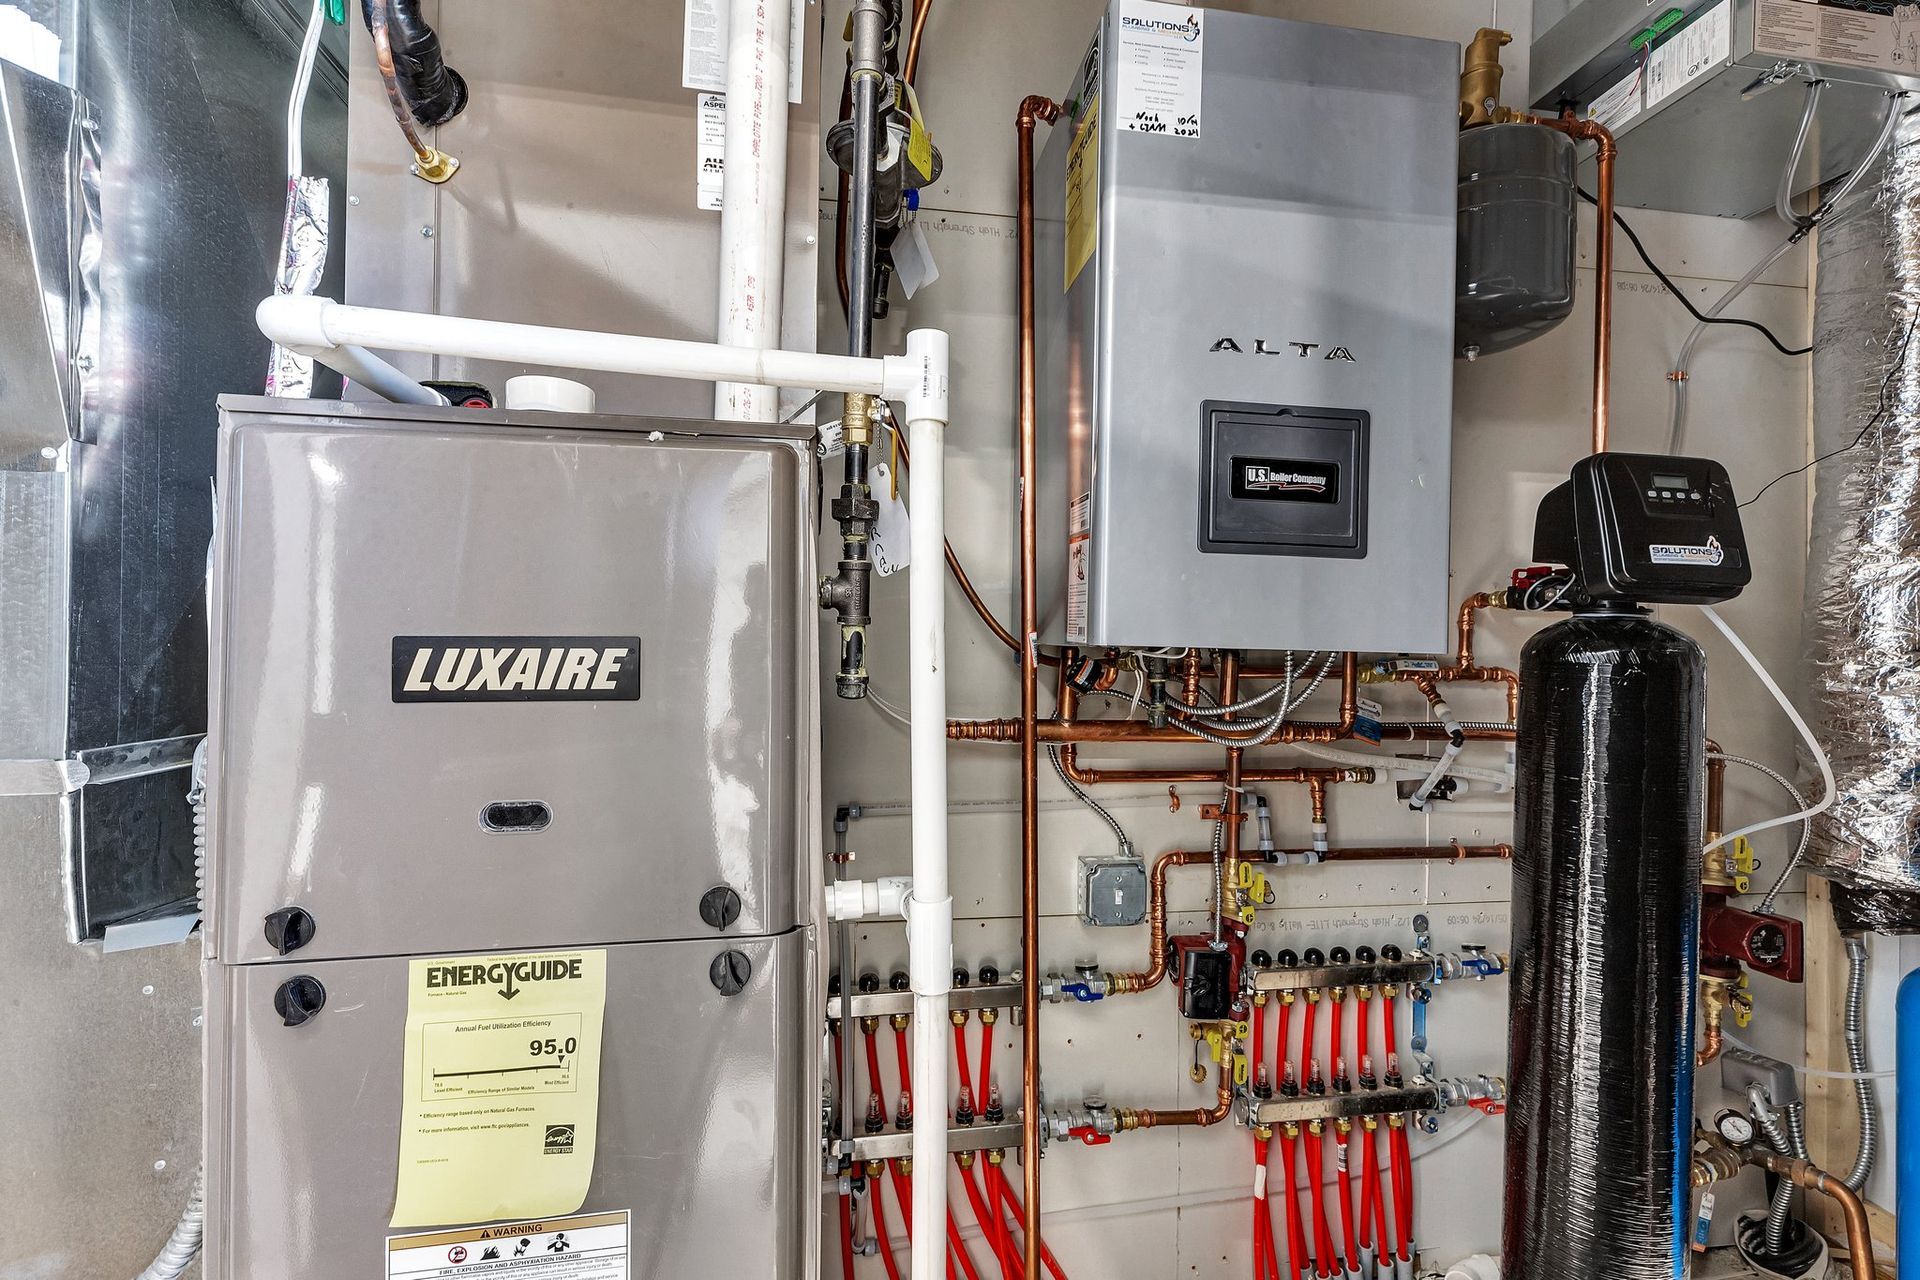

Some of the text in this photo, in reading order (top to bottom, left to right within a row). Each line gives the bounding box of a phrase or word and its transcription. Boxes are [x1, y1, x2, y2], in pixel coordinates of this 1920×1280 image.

[1122, 17, 1189, 33] SOLUTIONS
[1209, 338, 1357, 362] ALTA
[1248, 469, 1327, 486] U.S. Boiler Company
[1652, 546, 1713, 556] SOLUTIONS
[403, 647, 629, 692] LUXAIRE
[427, 959, 583, 989] ENERGYGUIDE
[455, 1020, 552, 1033] Annual Fuel Utilization Efficiency
[529, 1037, 577, 1057] 95.0
[493, 1223, 543, 1239] WARNING
[456, 1264, 494, 1274] EXPLOSION
[555, 1253, 582, 1262] HAZARD
